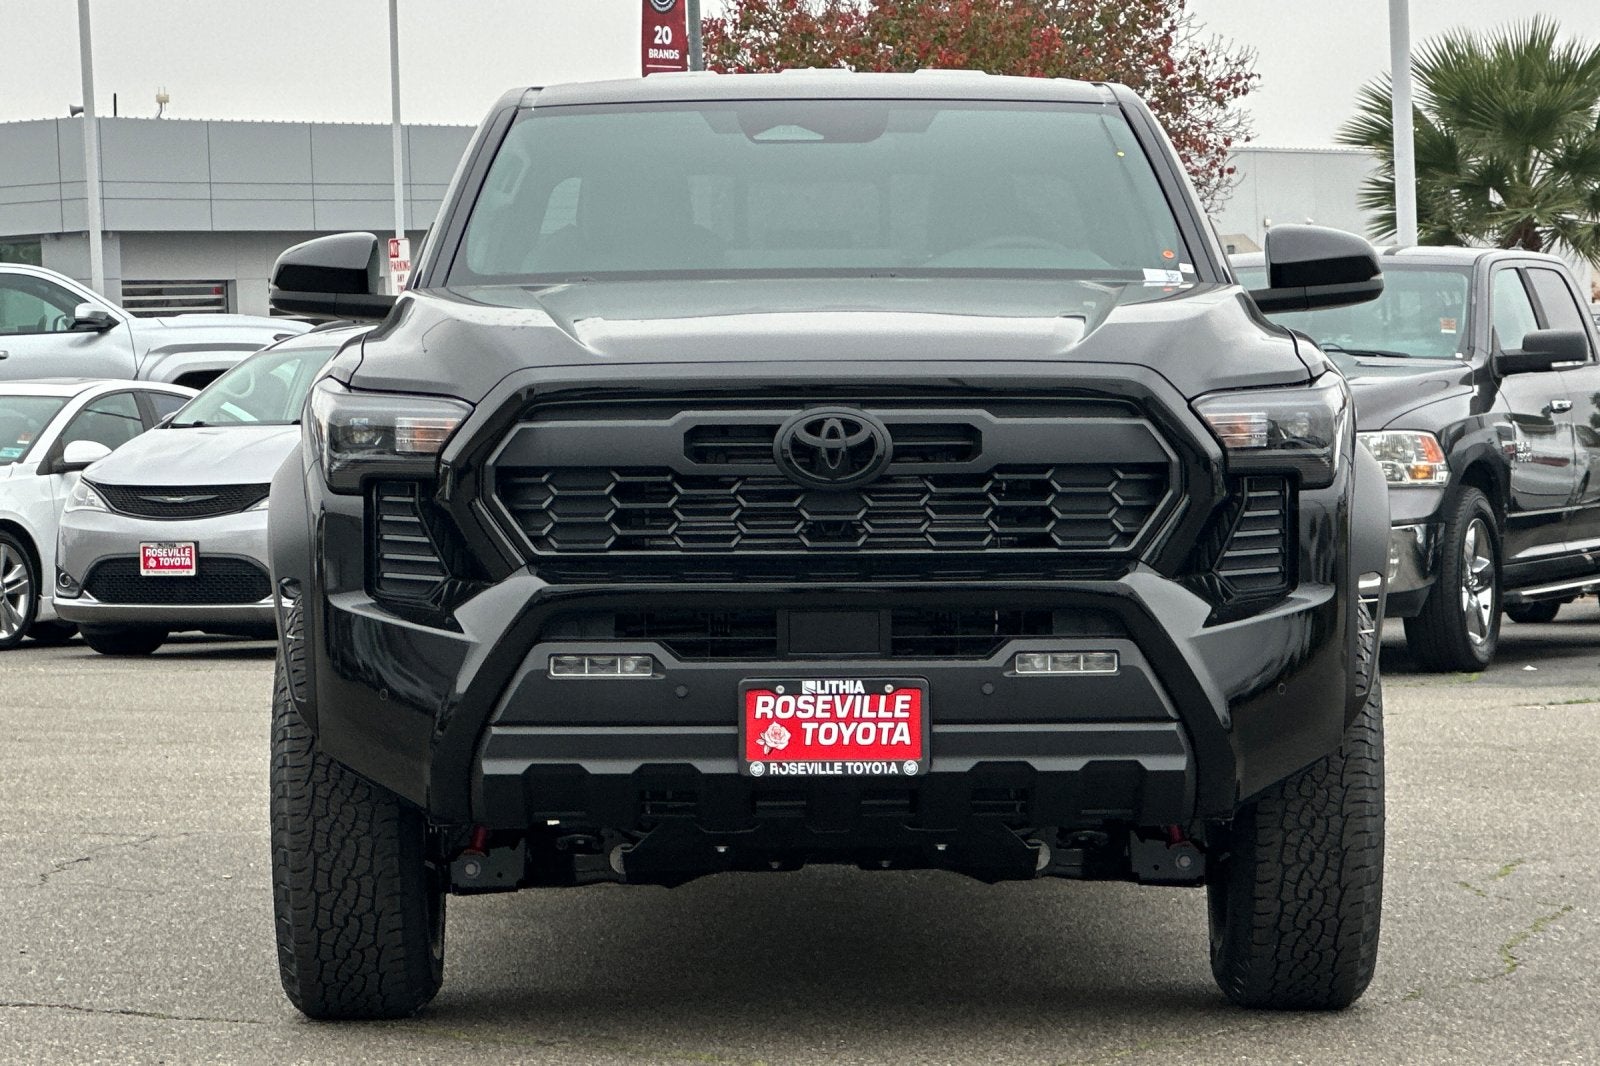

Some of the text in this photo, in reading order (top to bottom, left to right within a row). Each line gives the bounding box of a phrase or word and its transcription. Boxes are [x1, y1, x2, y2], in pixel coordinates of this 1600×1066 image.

[653, 25, 673, 45] 20
[648, 48, 680, 60] BRANDS
[145, 548, 191, 557] ROSEVILLE
[158, 557, 192, 566] TOYOTA
[816, 680, 866, 695] LITHIA
[754, 694, 912, 720] ROSEVILLE
[801, 721, 912, 747] TOYOTA
[769, 761, 899, 775] ROSEVILLE TOYOTA
